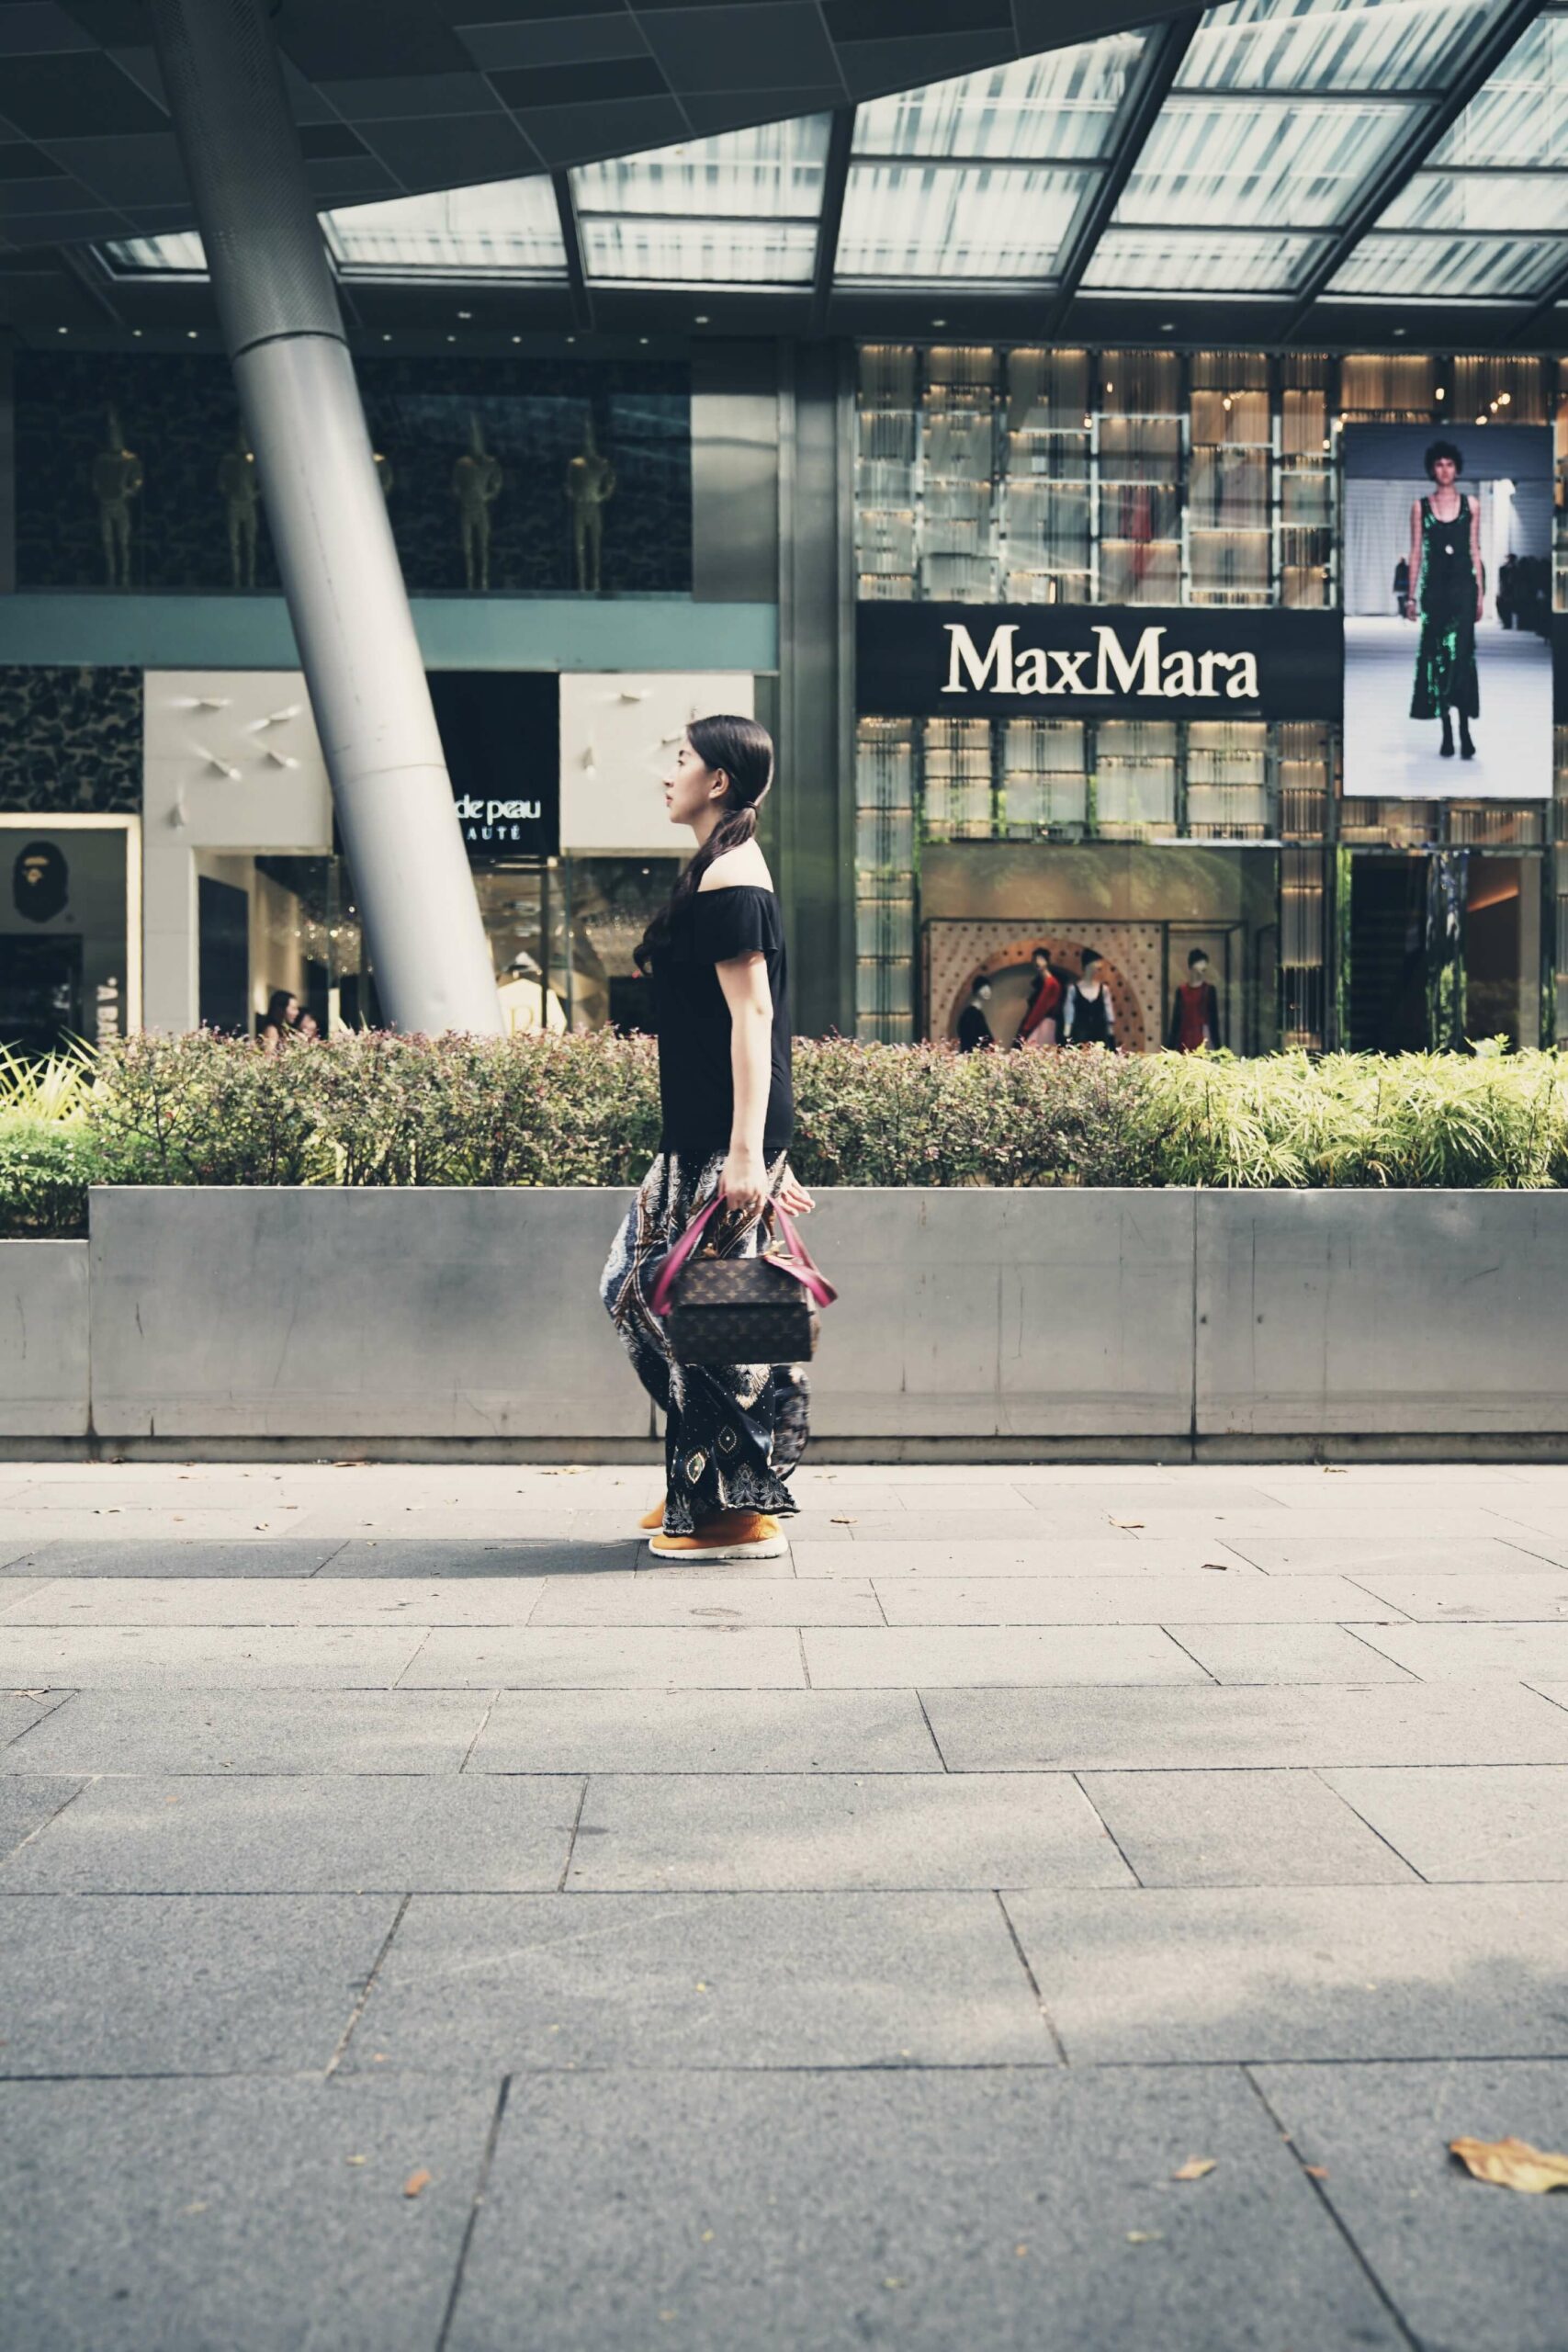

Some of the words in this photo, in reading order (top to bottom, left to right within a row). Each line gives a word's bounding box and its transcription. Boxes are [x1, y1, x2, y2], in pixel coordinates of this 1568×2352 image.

[941, 624, 1259, 697] MaxMara
[456, 793, 484, 819] de
[487, 799, 541, 826] peau
